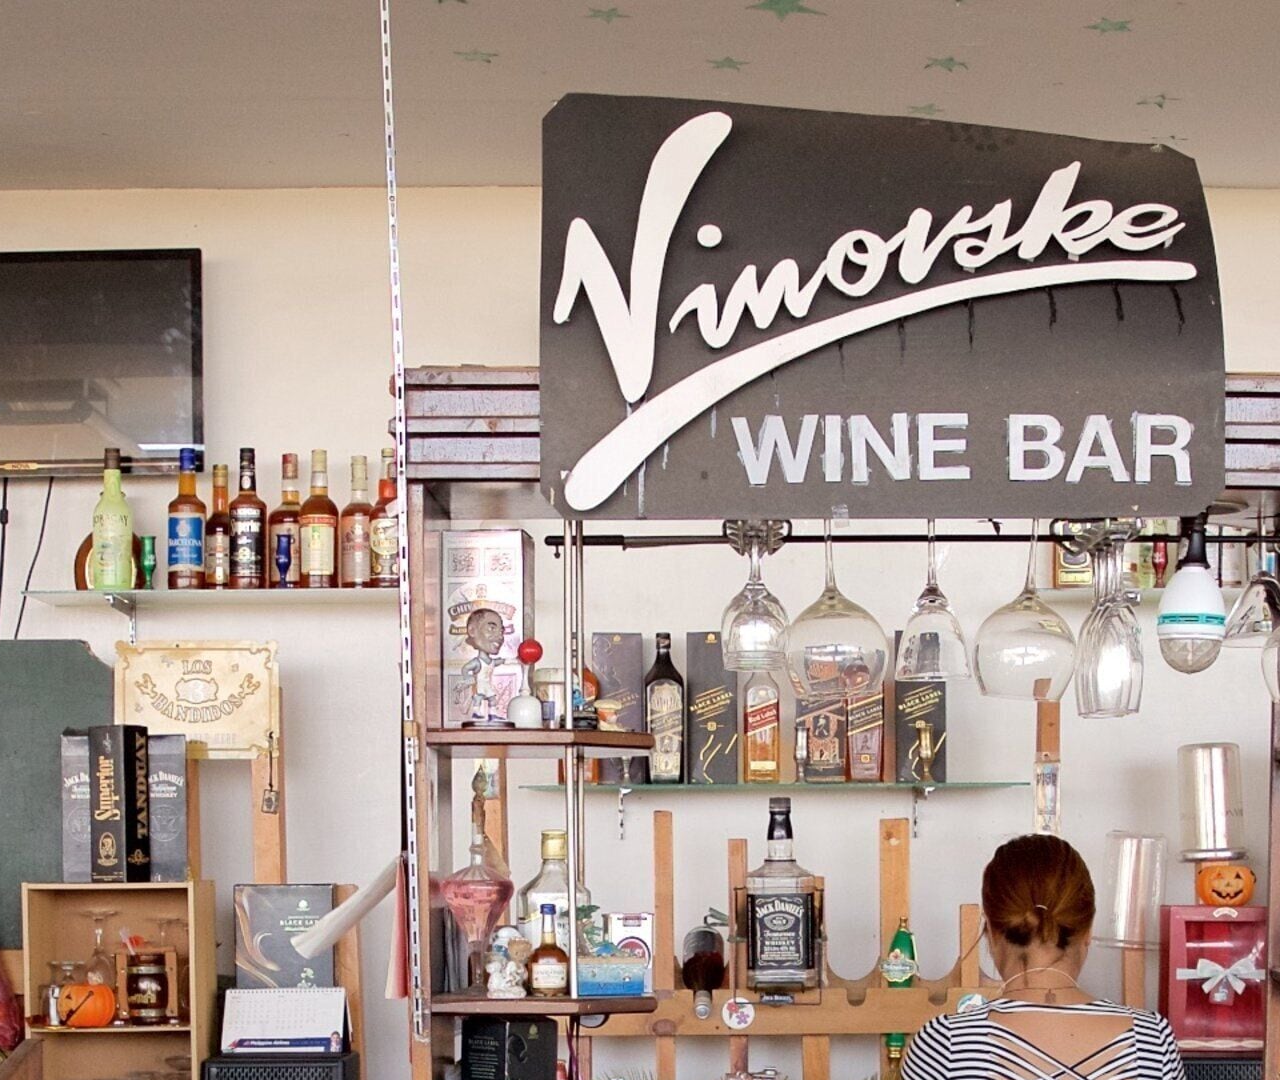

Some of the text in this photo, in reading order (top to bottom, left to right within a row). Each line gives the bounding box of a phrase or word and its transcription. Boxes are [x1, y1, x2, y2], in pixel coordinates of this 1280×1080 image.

[553, 111, 1187, 403] Vinovske
[731, 413, 1193, 485] WINE BAR
[182, 660, 212, 676] LOS
[151, 692, 244, 724] BANDIDOS
[689, 691, 734, 712] BLACK LABEL
[898, 690, 944, 711] BLACK LABEL
[94, 755, 121, 821] Superior
[135, 731, 148, 840] TANDUAY
